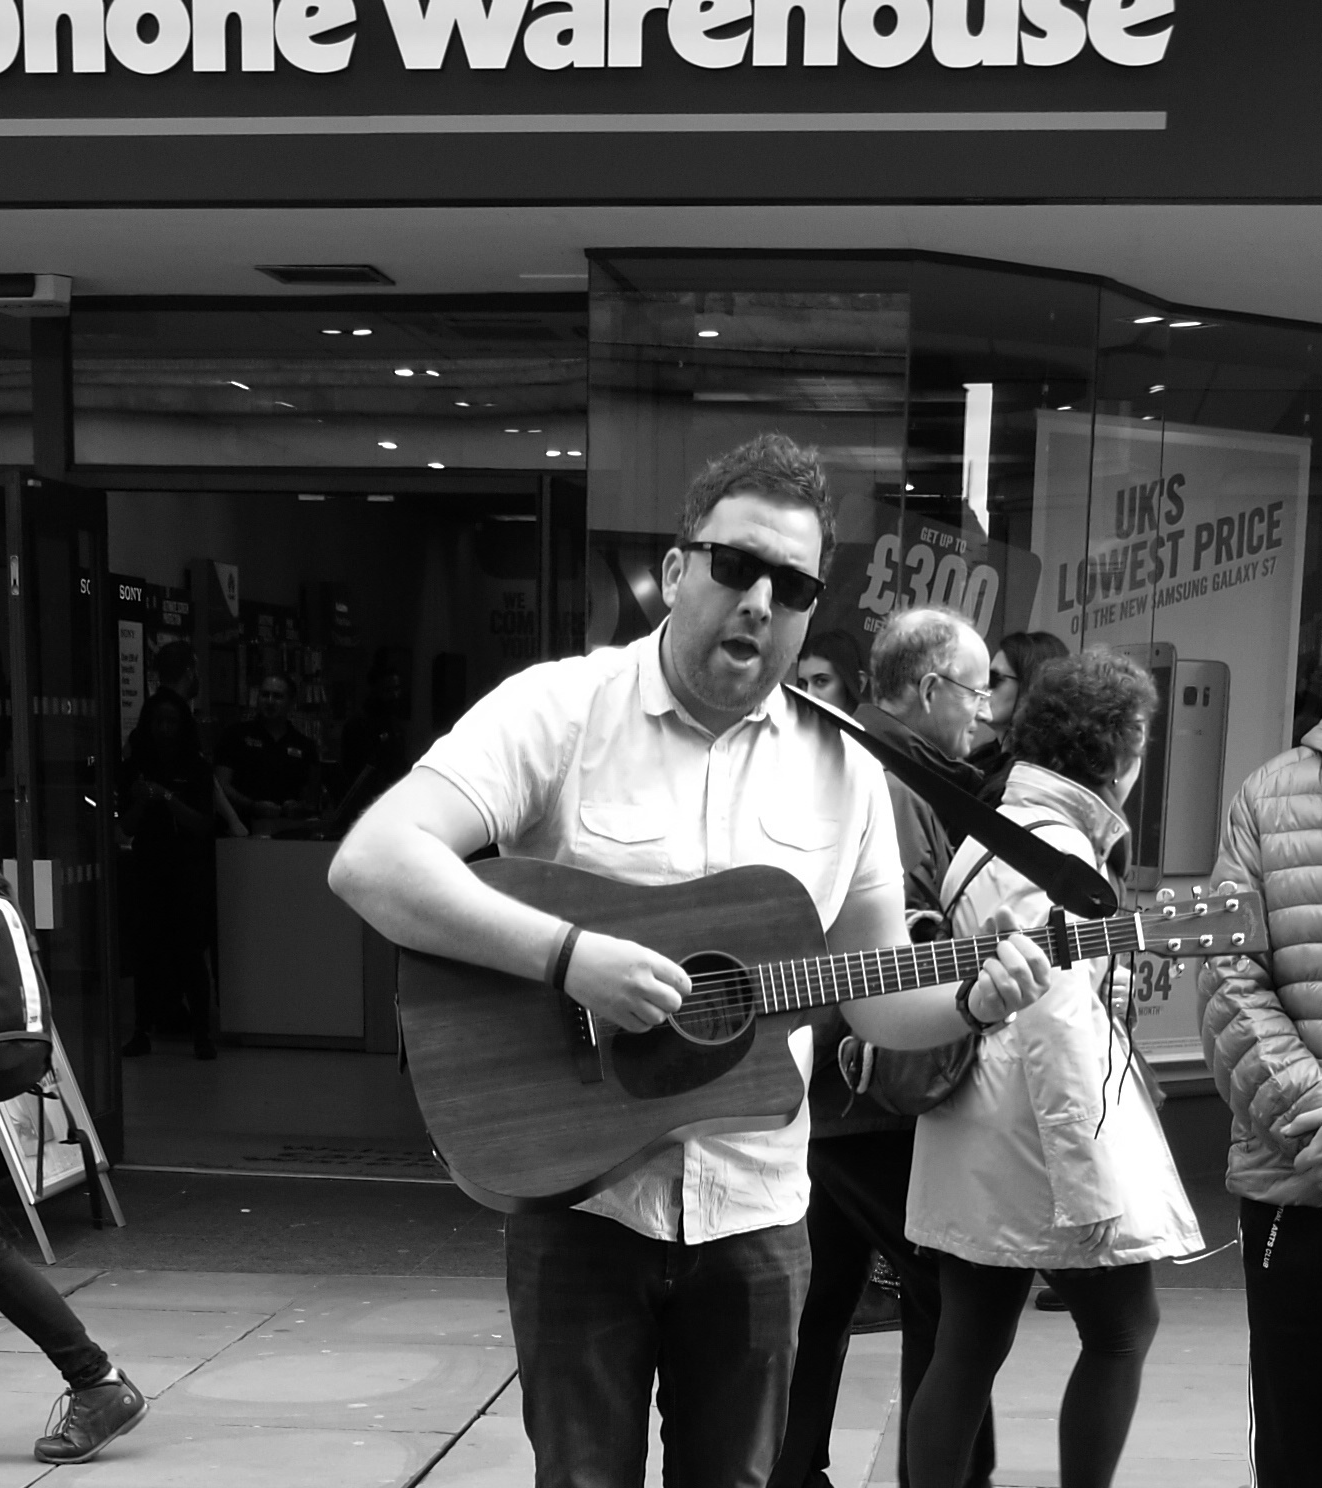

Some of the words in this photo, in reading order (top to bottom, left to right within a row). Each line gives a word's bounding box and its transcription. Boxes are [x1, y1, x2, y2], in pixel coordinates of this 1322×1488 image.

[382, 0, 1175, 69] Warehouse
[1115, 473, 1186, 540] UK'S
[920, 526, 939, 545] GET
[940, 533, 954, 549] UP
[955, 538, 968, 554] TO
[1057, 529, 1185, 613] LOWEST
[1192, 501, 1284, 572] PRICE
[119, 584, 142, 602] SONY
[858, 533, 1000, 640] £300
[1093, 604, 1116, 629] THE
[1119, 594, 1148, 621] NEW
[1151, 576, 1208, 610] SAMSUNG
[1212, 561, 1259, 592] GALAXY
[1261, 556, 1277, 578] S7
[1133, 959, 1172, 1002] 34
[1262, 1248, 1272, 1269] CLUB
[1267, 1223, 1278, 1247] ARTS
